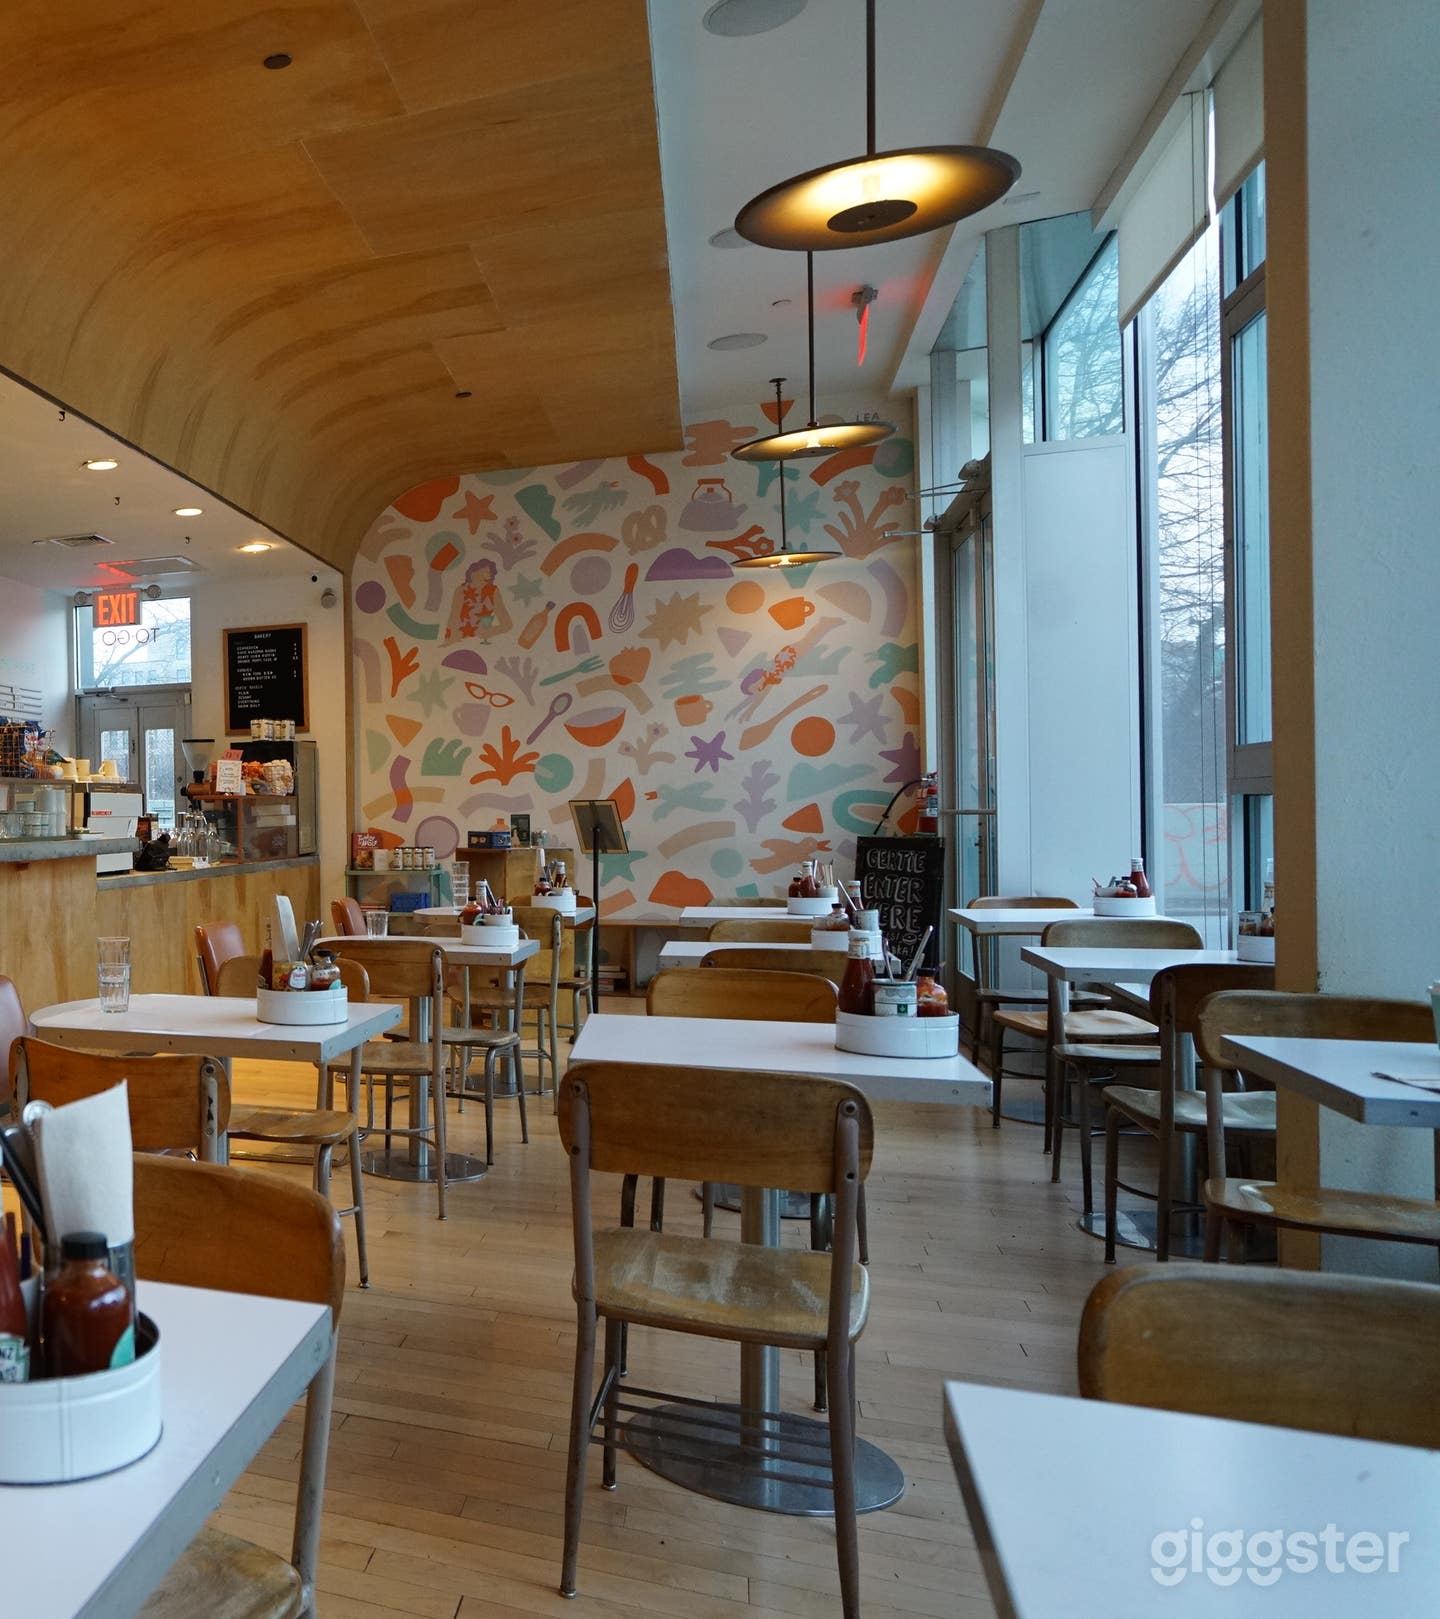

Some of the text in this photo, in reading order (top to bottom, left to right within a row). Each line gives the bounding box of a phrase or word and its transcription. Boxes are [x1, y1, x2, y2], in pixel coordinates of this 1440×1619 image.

[97, 592, 137, 626] EXIT
[866, 848, 927, 874] GERTIE
[863, 873, 924, 904] ENTER
[866, 902, 923, 933] ERE
